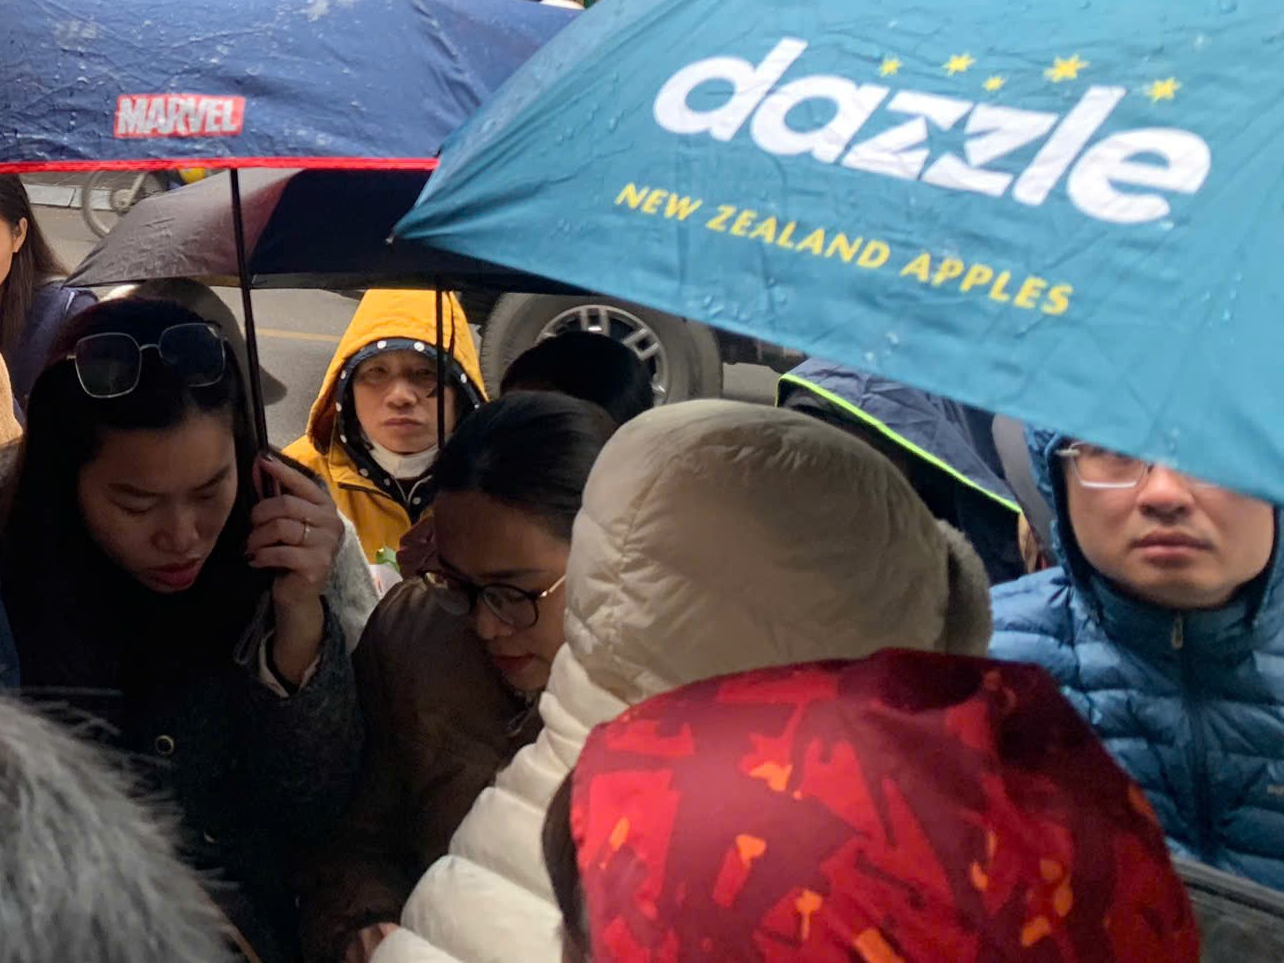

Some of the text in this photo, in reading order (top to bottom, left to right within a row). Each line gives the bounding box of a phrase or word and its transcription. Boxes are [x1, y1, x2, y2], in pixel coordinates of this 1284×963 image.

[117, 97, 237, 135] MARVEL
[652, 37, 1212, 224] dazzle
[616, 181, 1074, 316] NEW ZEALAND APPLES
